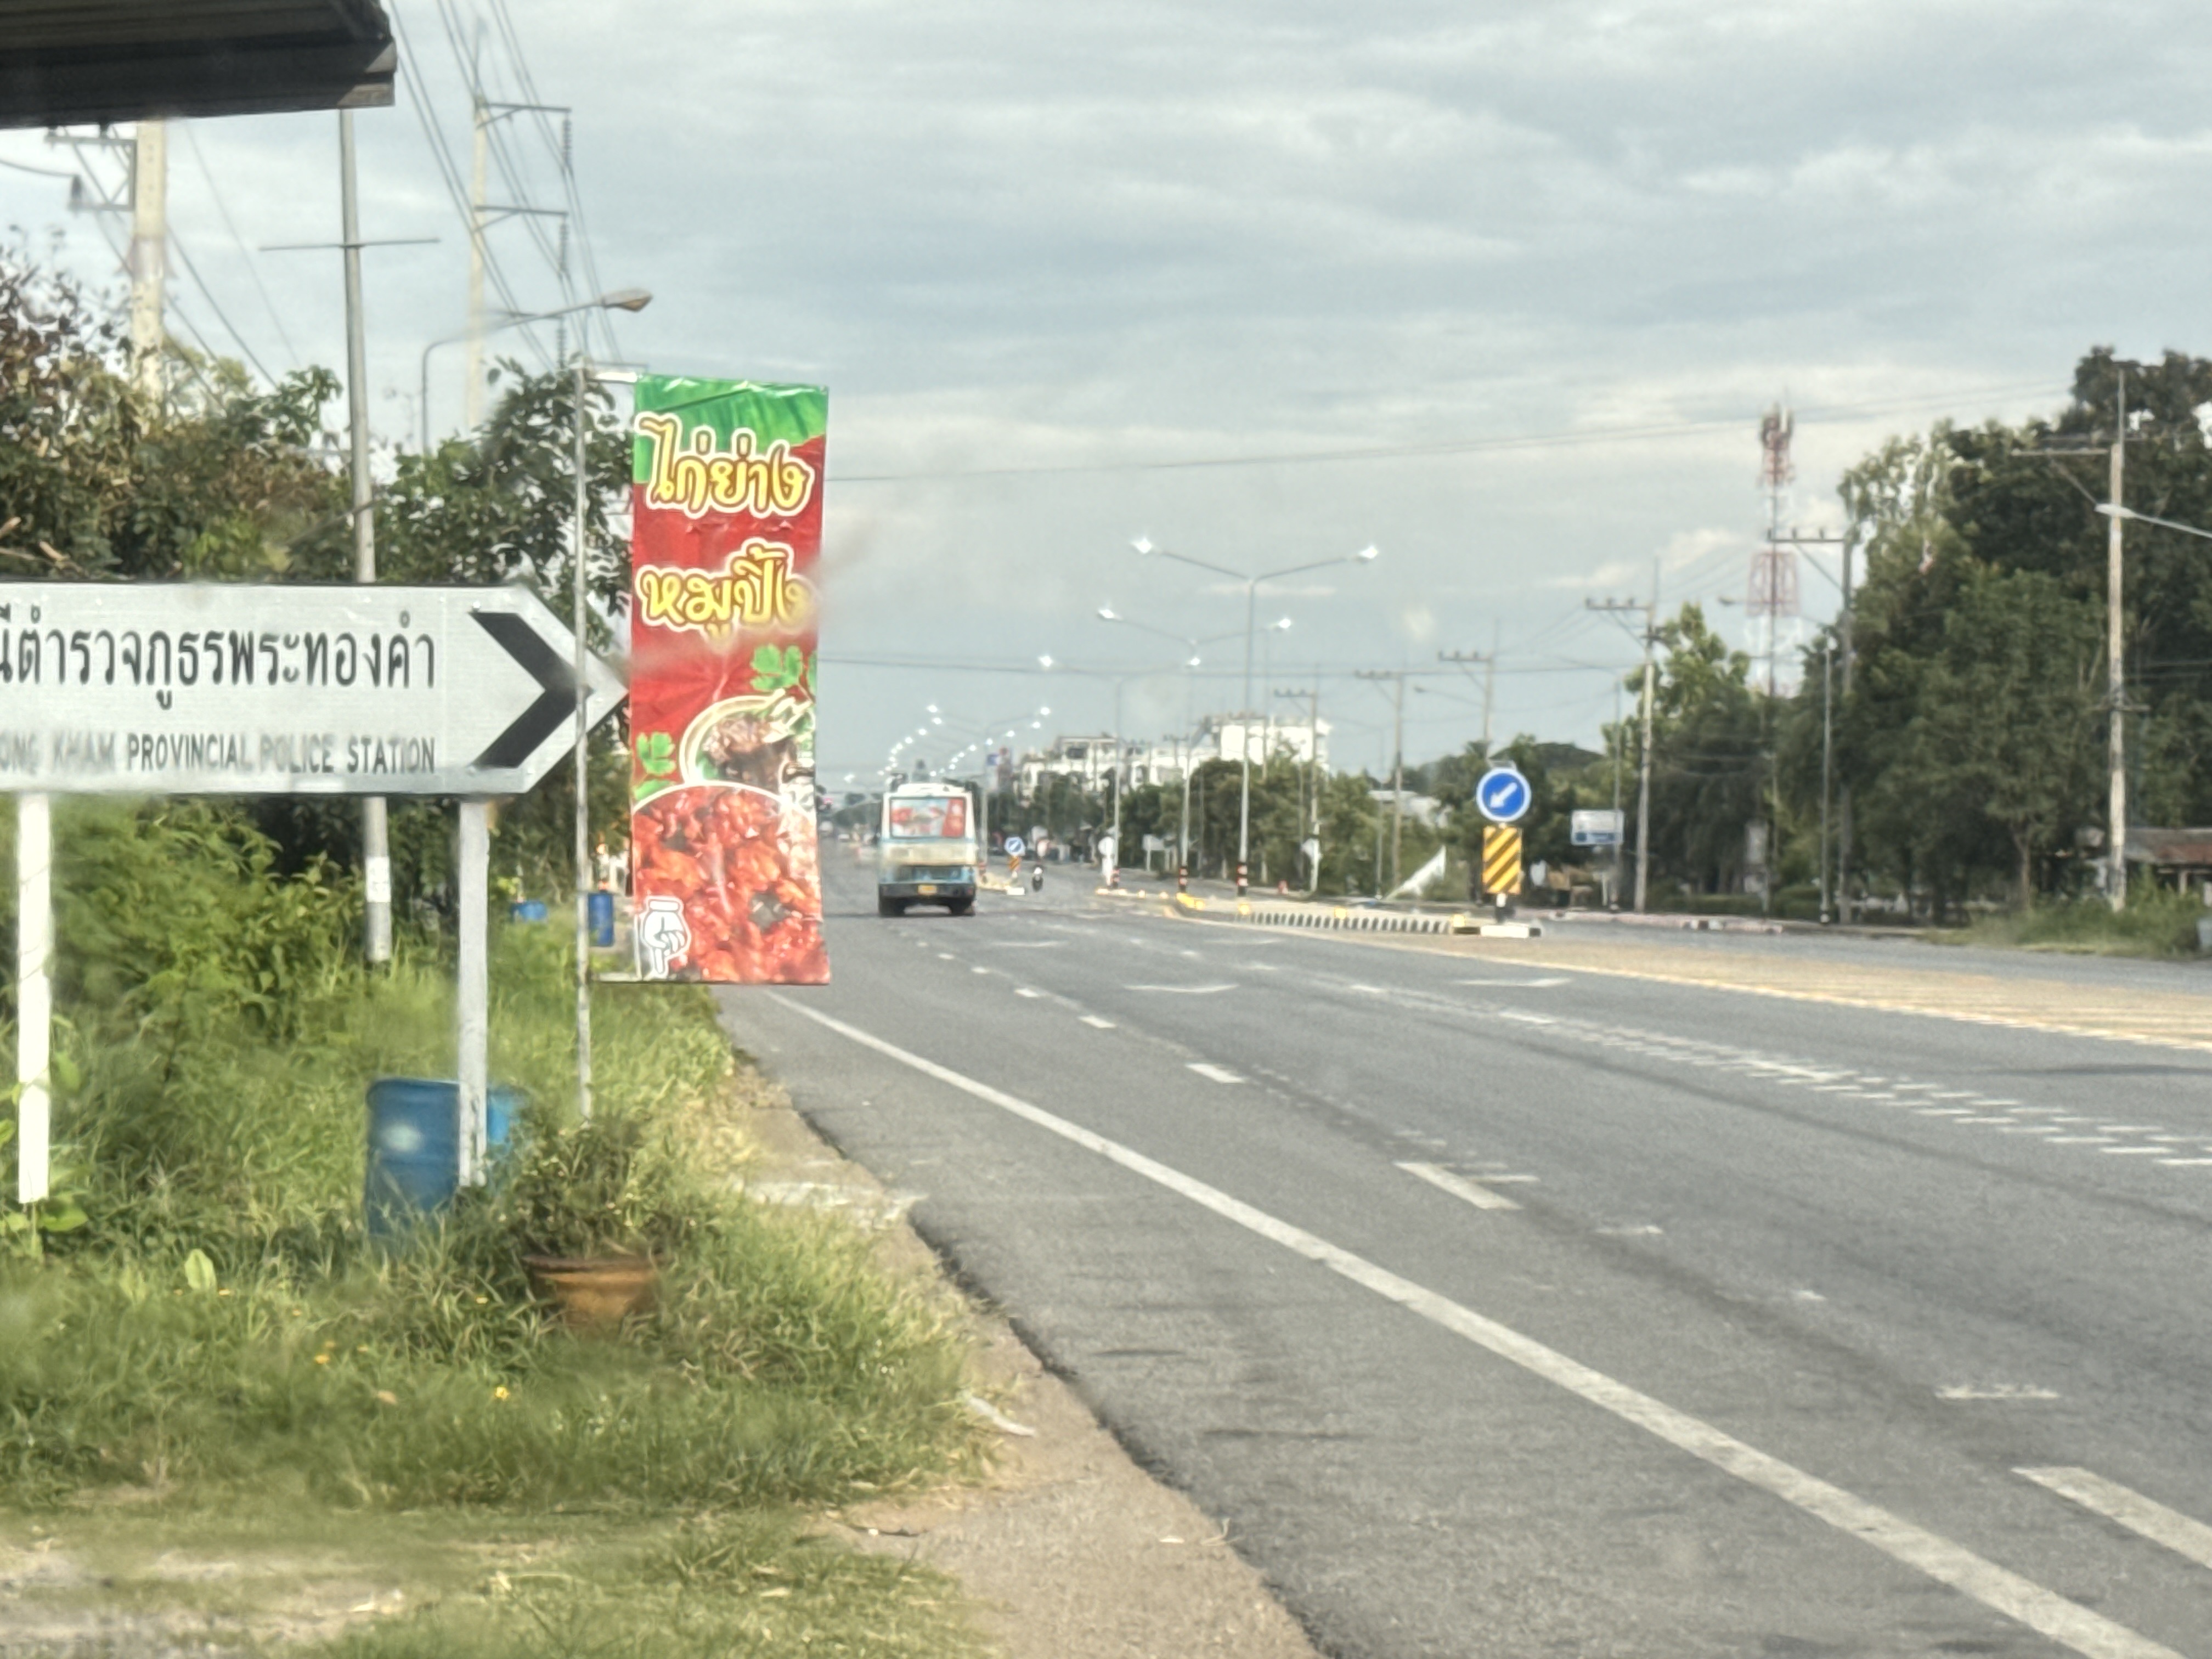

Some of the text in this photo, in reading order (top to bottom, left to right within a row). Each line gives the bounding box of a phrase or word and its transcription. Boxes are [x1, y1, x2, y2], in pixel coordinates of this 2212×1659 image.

[635, 414, 813, 517] ไก่ย่าง
[637, 539, 815, 643] หมูปิ้ง
[126, 732, 254, 772] PROVINCIAL
[259, 733, 335, 774] POLICE
[347, 735, 435, 774] STATION
